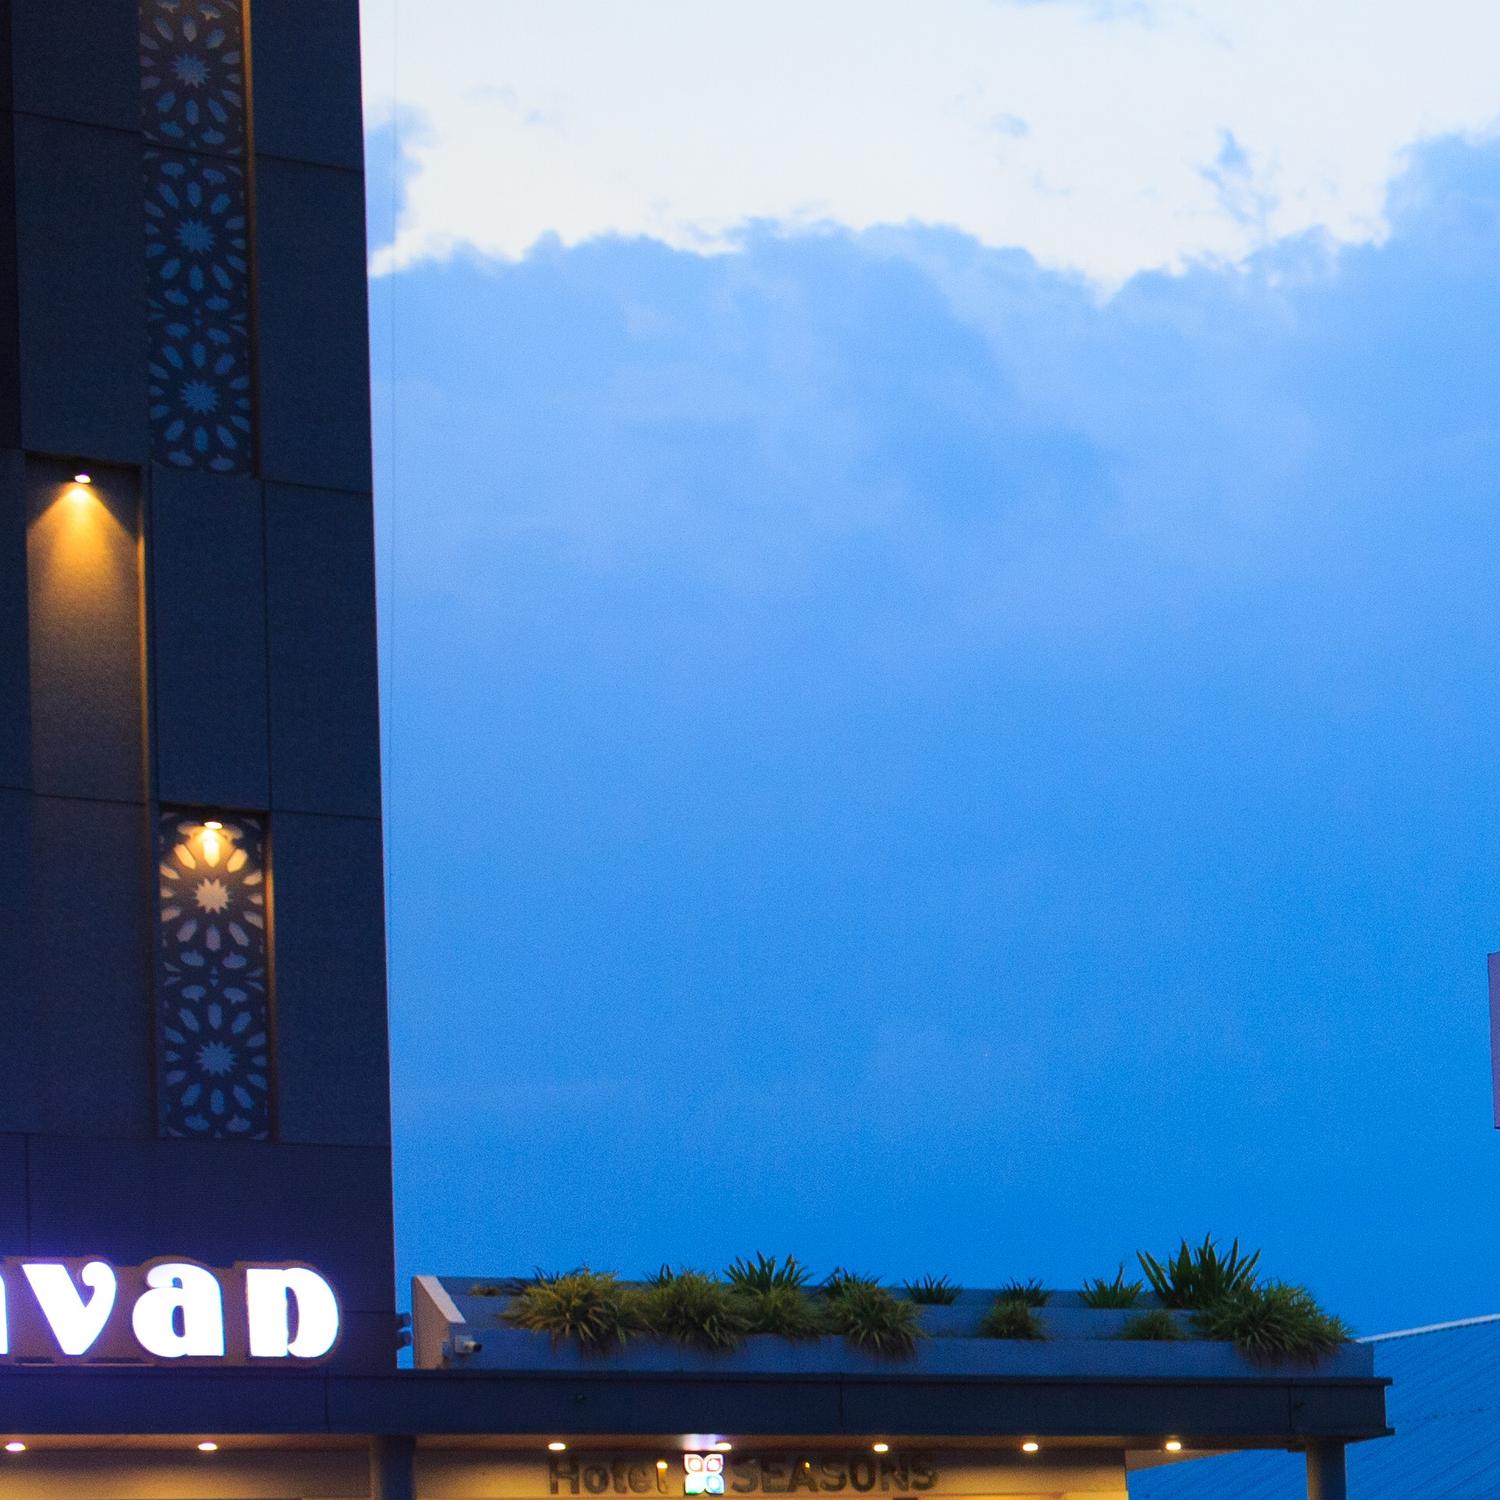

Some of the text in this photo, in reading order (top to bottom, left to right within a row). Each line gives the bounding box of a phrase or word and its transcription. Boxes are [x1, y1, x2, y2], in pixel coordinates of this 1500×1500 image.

[0, 1261, 339, 1358] van
[548, 1452, 938, 1495] Hotel SEASONS
